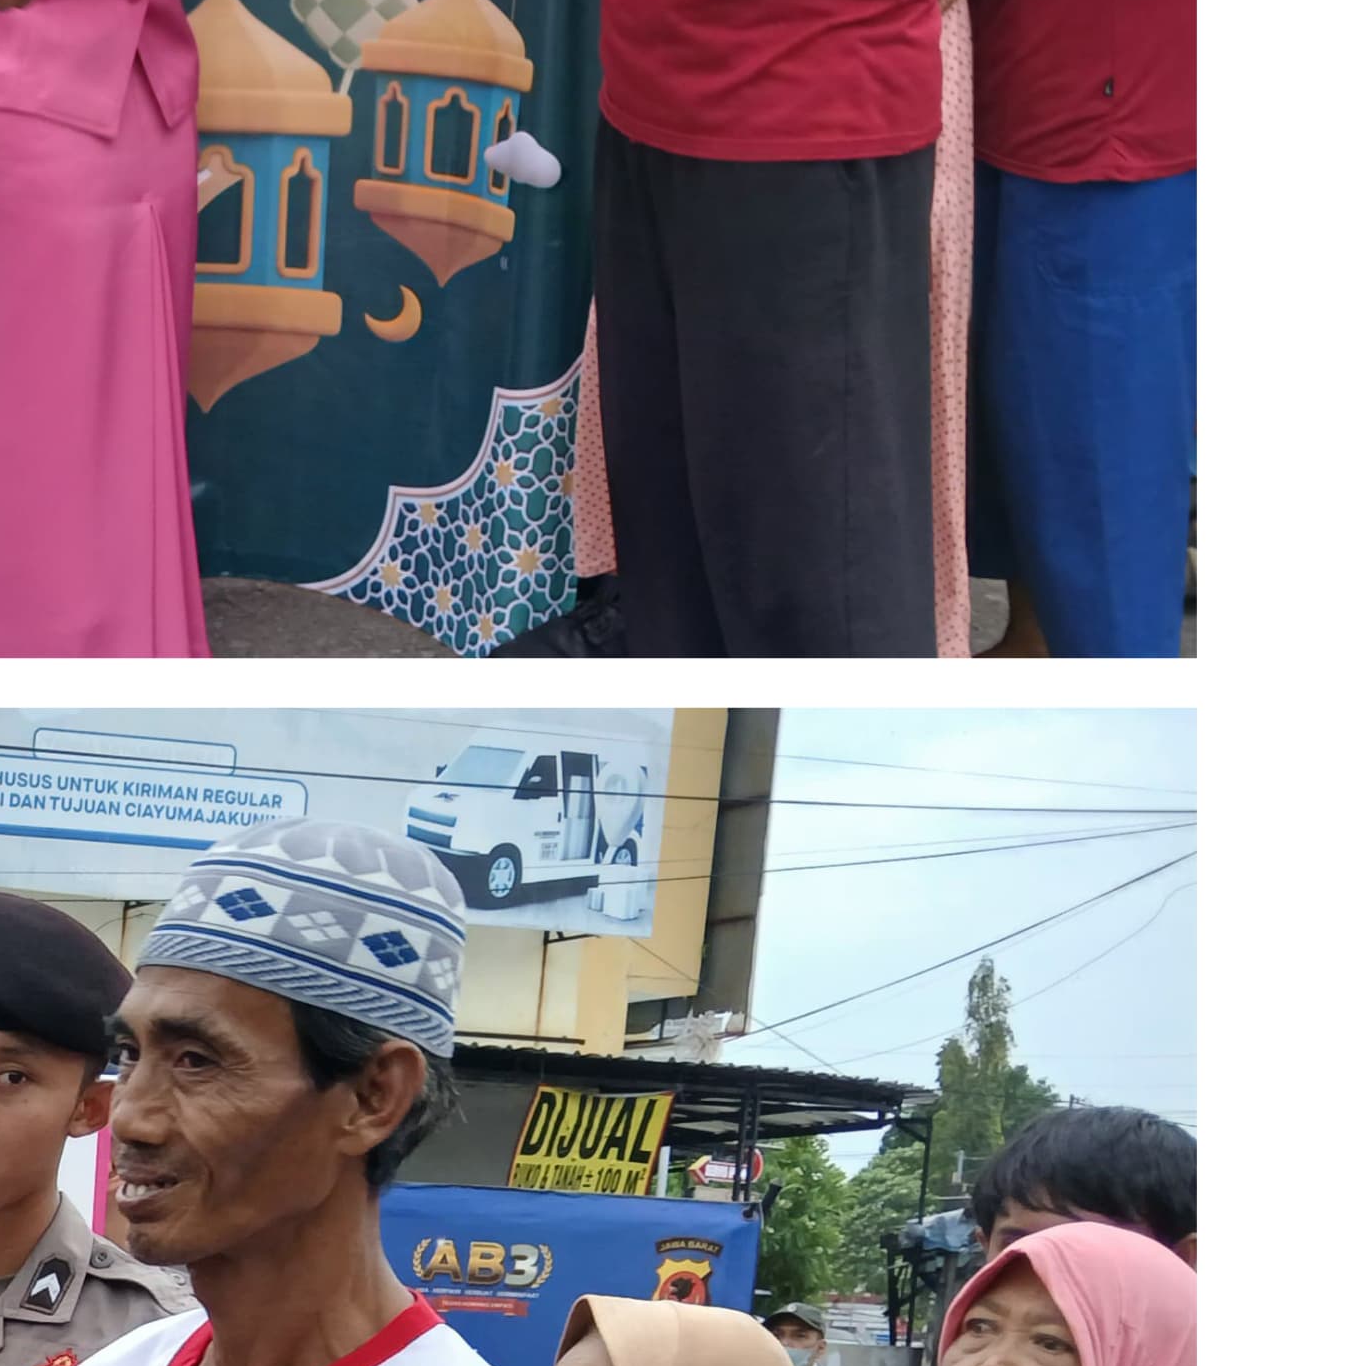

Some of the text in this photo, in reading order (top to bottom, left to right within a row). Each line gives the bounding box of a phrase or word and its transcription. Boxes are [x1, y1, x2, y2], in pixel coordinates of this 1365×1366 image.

[57, 775, 118, 795] UNTUK
[123, 781, 198, 802] KIRIMAN
[202, 788, 282, 809] REGULAR
[9, 793, 45, 810] DAN
[50, 795, 120, 816] TUJUAN
[125, 802, 291, 827] CIAYUMAJAKUN
[521, 1092, 657, 1164] DIJUAL
[595, 1167, 621, 1193] 100
[421, 1238, 539, 1288] AB3
[688, 1240, 721, 1253] BARAT
